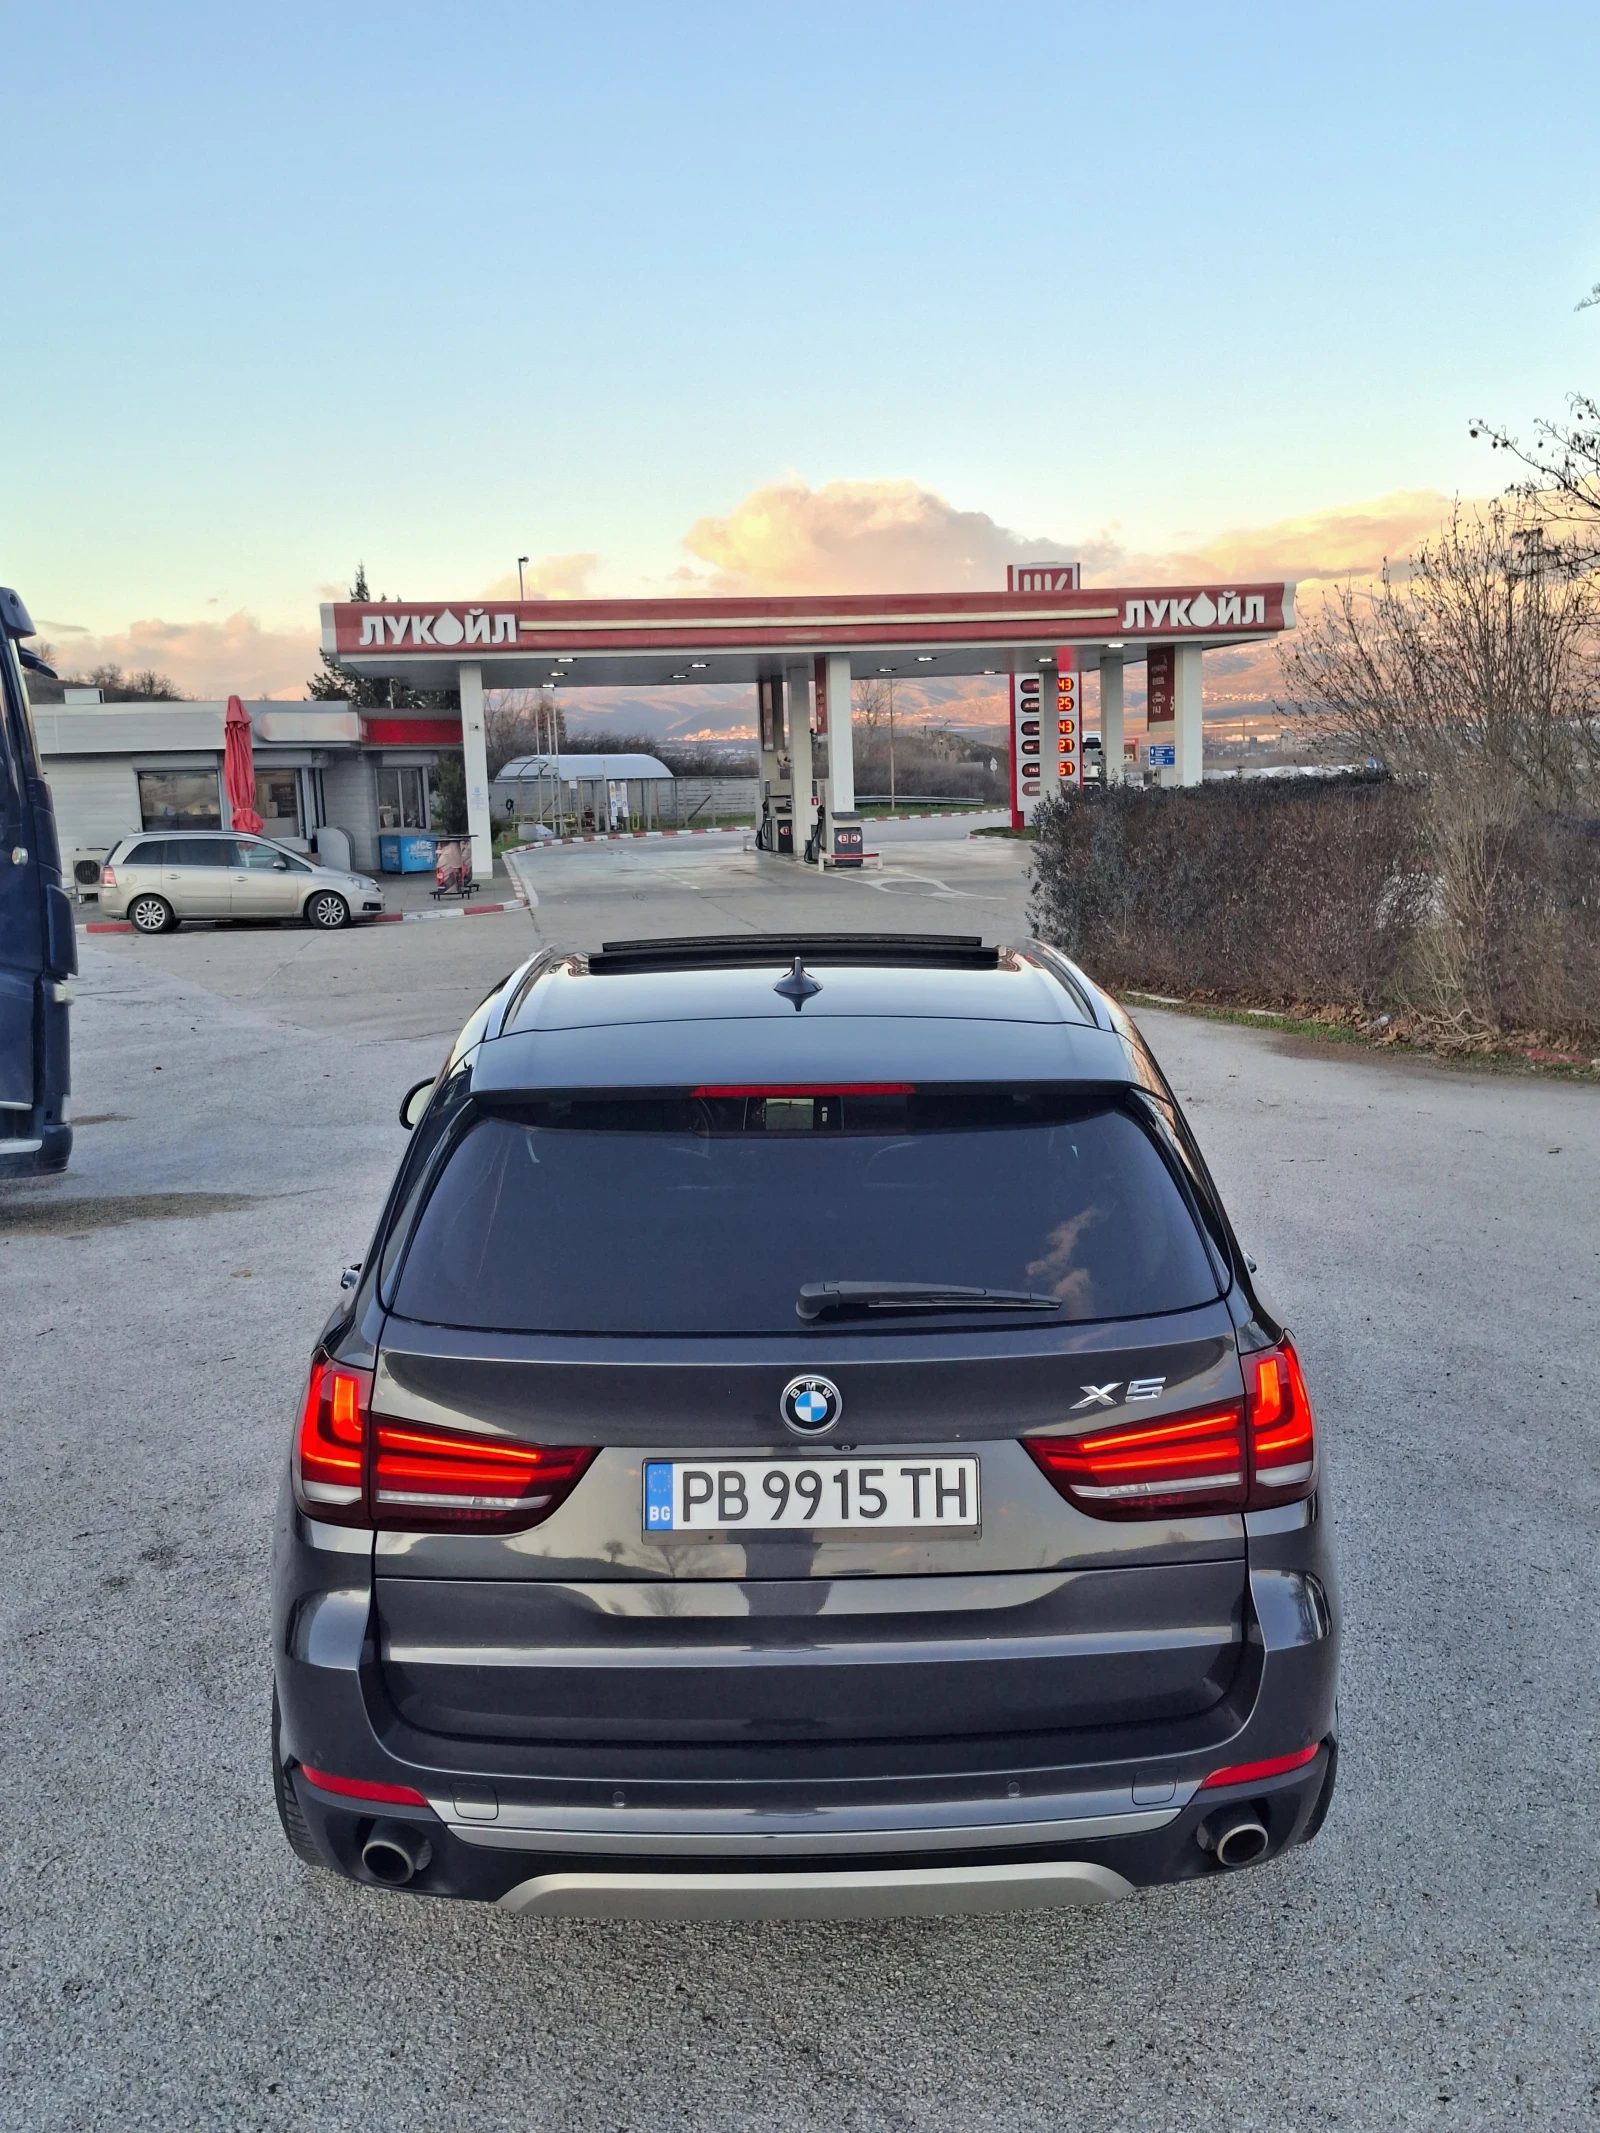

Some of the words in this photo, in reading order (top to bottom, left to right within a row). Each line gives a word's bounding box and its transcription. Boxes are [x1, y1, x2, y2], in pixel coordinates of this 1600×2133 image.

[1122, 591, 1266, 628] ЛУКОЙЛ
[359, 608, 517, 646] ЛУКОЙЛ
[416, 840, 433, 850] ICE
[790, 1382, 833, 1399] BMW
[1069, 1376, 1167, 1410] X5
[682, 1470, 748, 1522] PB
[762, 1468, 887, 1521] 9915
[899, 1466, 968, 1519] TH
[649, 1505, 671, 1522] BG
